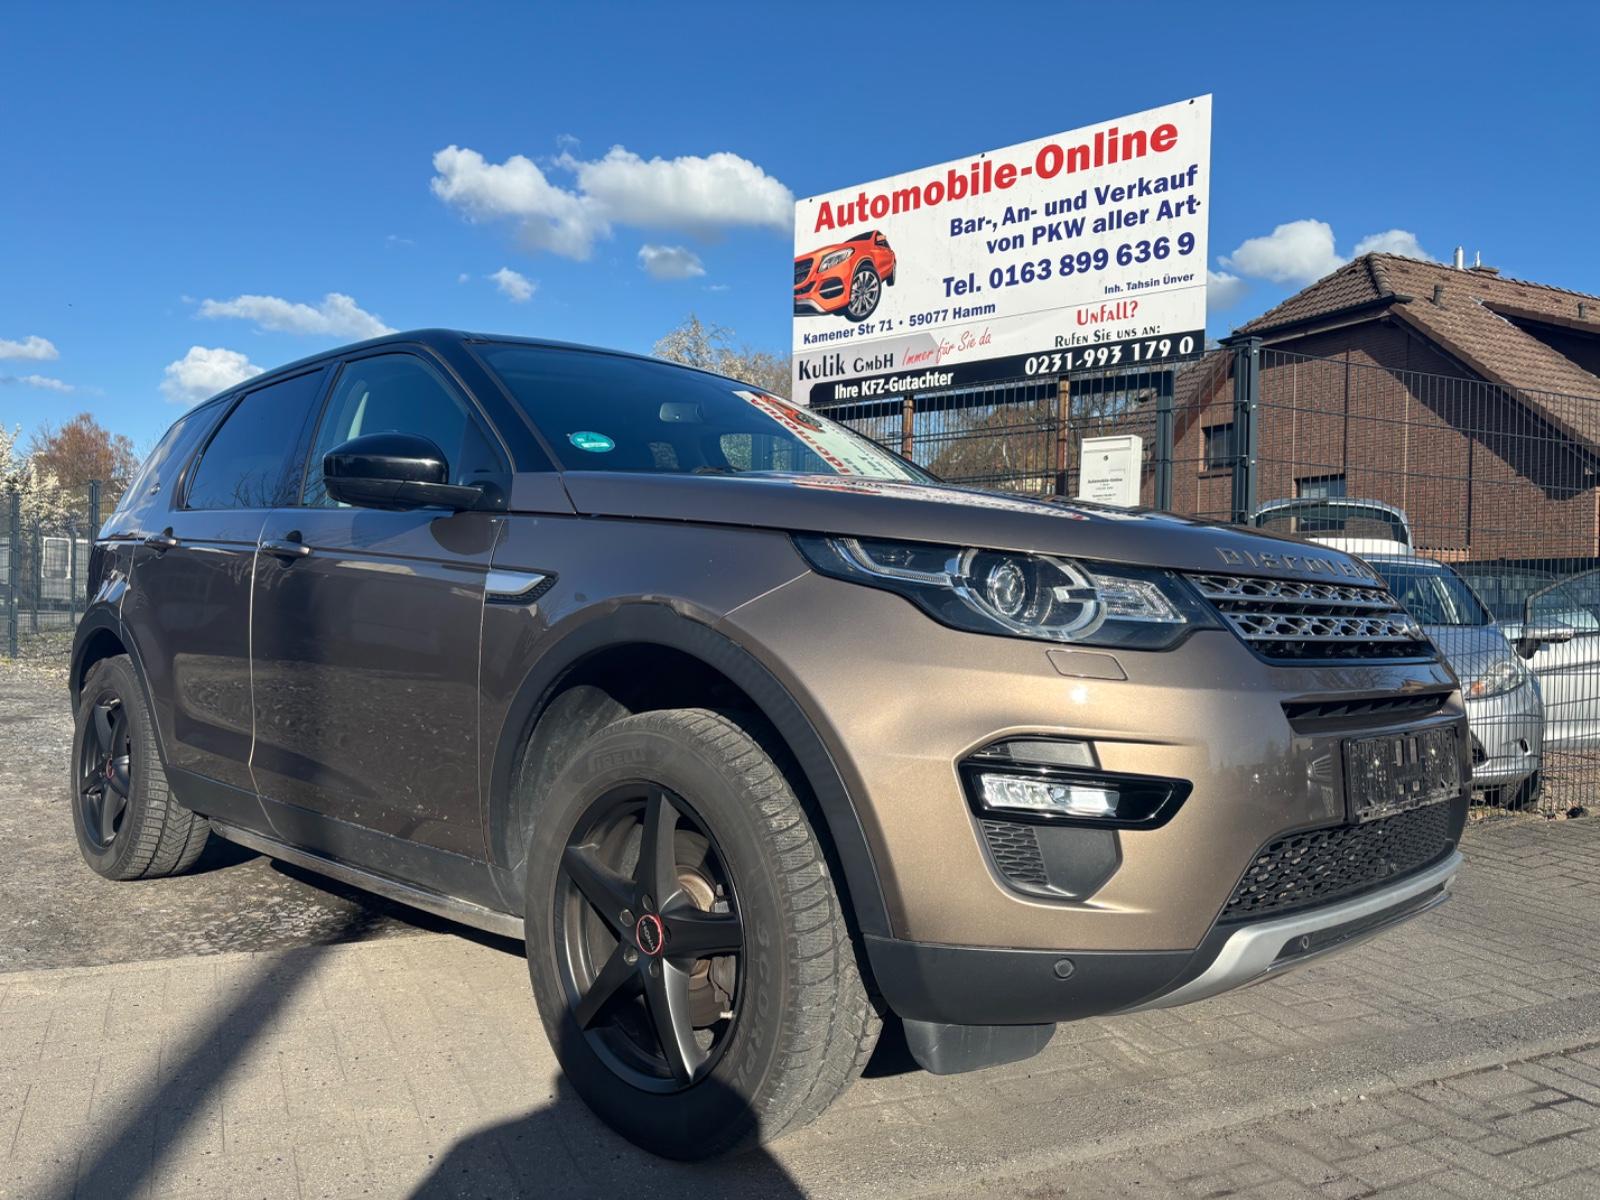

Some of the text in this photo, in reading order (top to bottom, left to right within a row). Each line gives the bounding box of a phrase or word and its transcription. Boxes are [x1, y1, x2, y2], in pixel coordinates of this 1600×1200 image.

[814, 123, 1178, 232] Automobile-Online
[950, 164, 1198, 237] Bar-, An- und Verkauf
[986, 194, 1195, 254] von PKW aller Art
[943, 232, 1195, 297] Tel. 0163 899 636 9
[1104, 273, 1194, 294] Inh. Tahsin Ünver
[803, 302, 995, 345] Kamener Str 71 59077 Hamm
[799, 353, 845, 381] Kulik
[901, 327, 991, 367] Immer für Sie da
[1025, 336, 1193, 375] 0231-993 179 0
[834, 371, 954, 400] Ihre KFZ-Gutachter
